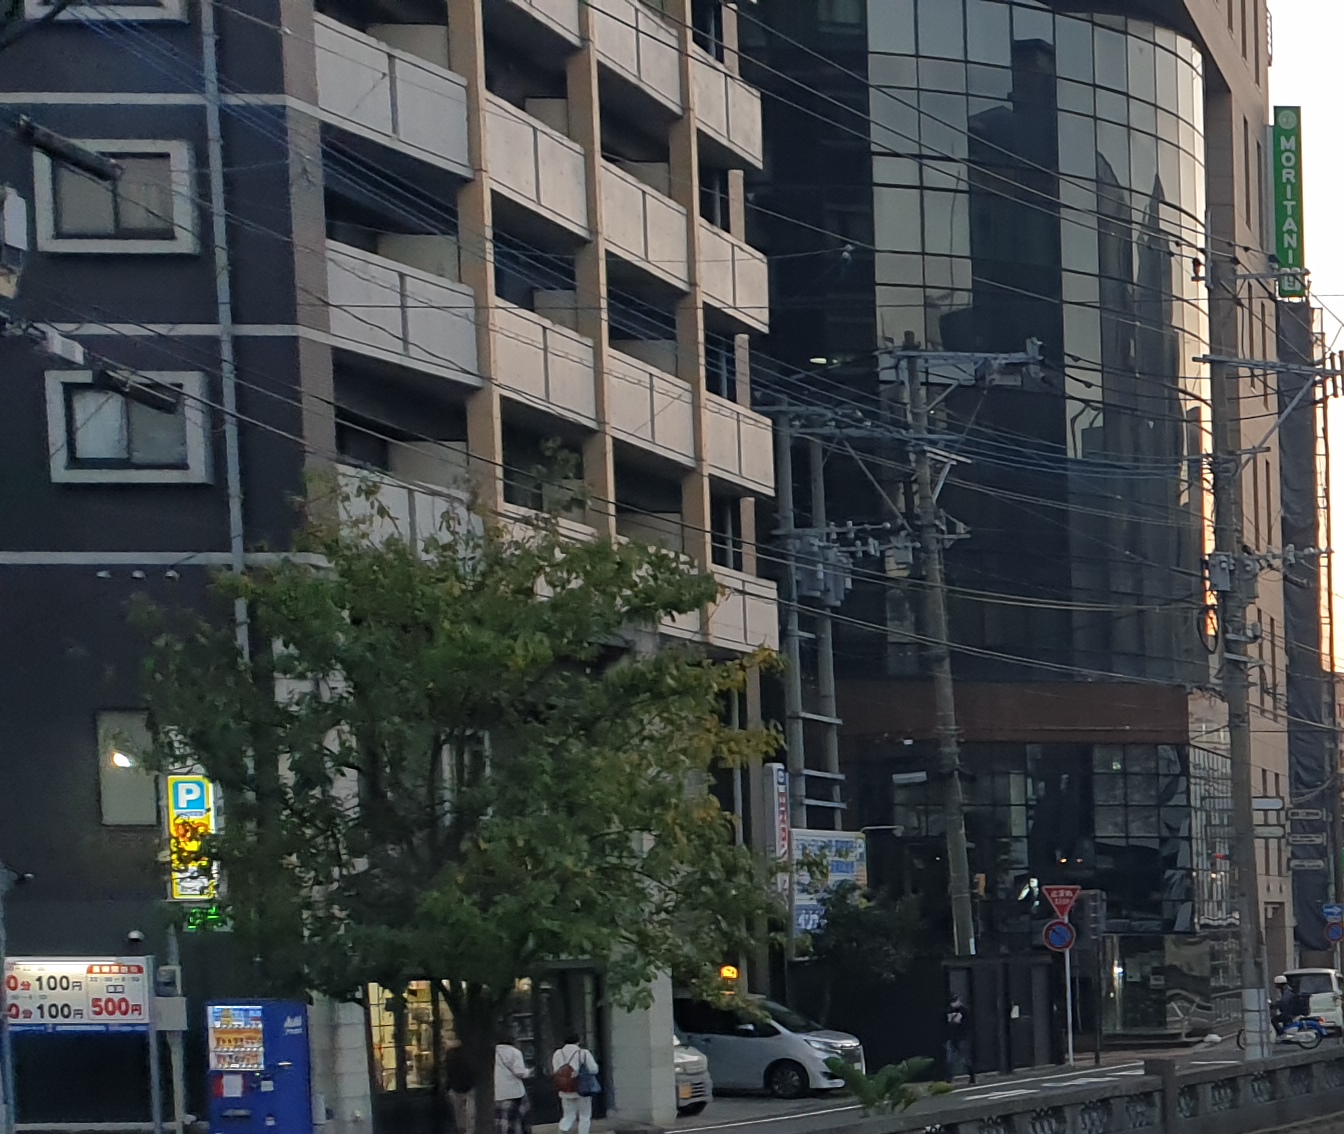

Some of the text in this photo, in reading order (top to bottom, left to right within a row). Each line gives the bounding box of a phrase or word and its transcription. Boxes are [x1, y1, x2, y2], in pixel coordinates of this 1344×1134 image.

[1280, 135, 1298, 264] MORITANI
[178, 783, 201, 808] P
[36, 975, 82, 991] 100円
[37, 1003, 83, 1019] 100円
[91, 997, 142, 1016] 500円
